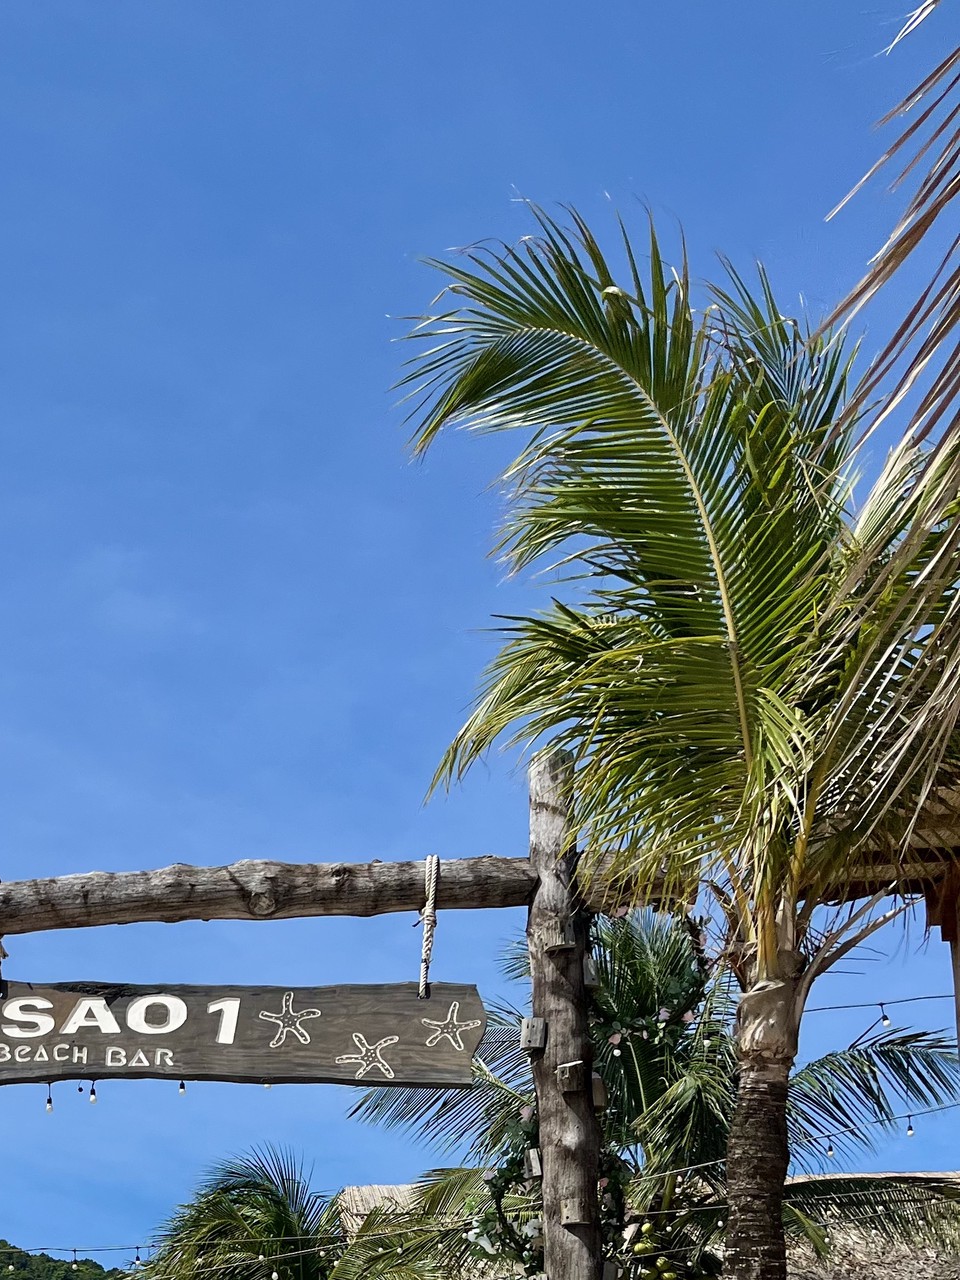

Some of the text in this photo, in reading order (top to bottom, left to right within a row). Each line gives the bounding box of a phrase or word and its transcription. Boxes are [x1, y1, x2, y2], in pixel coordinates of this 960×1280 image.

[1, 994, 187, 1038] SAO
[207, 997, 241, 1044] 1
[105, 1046, 174, 1067] BAR
